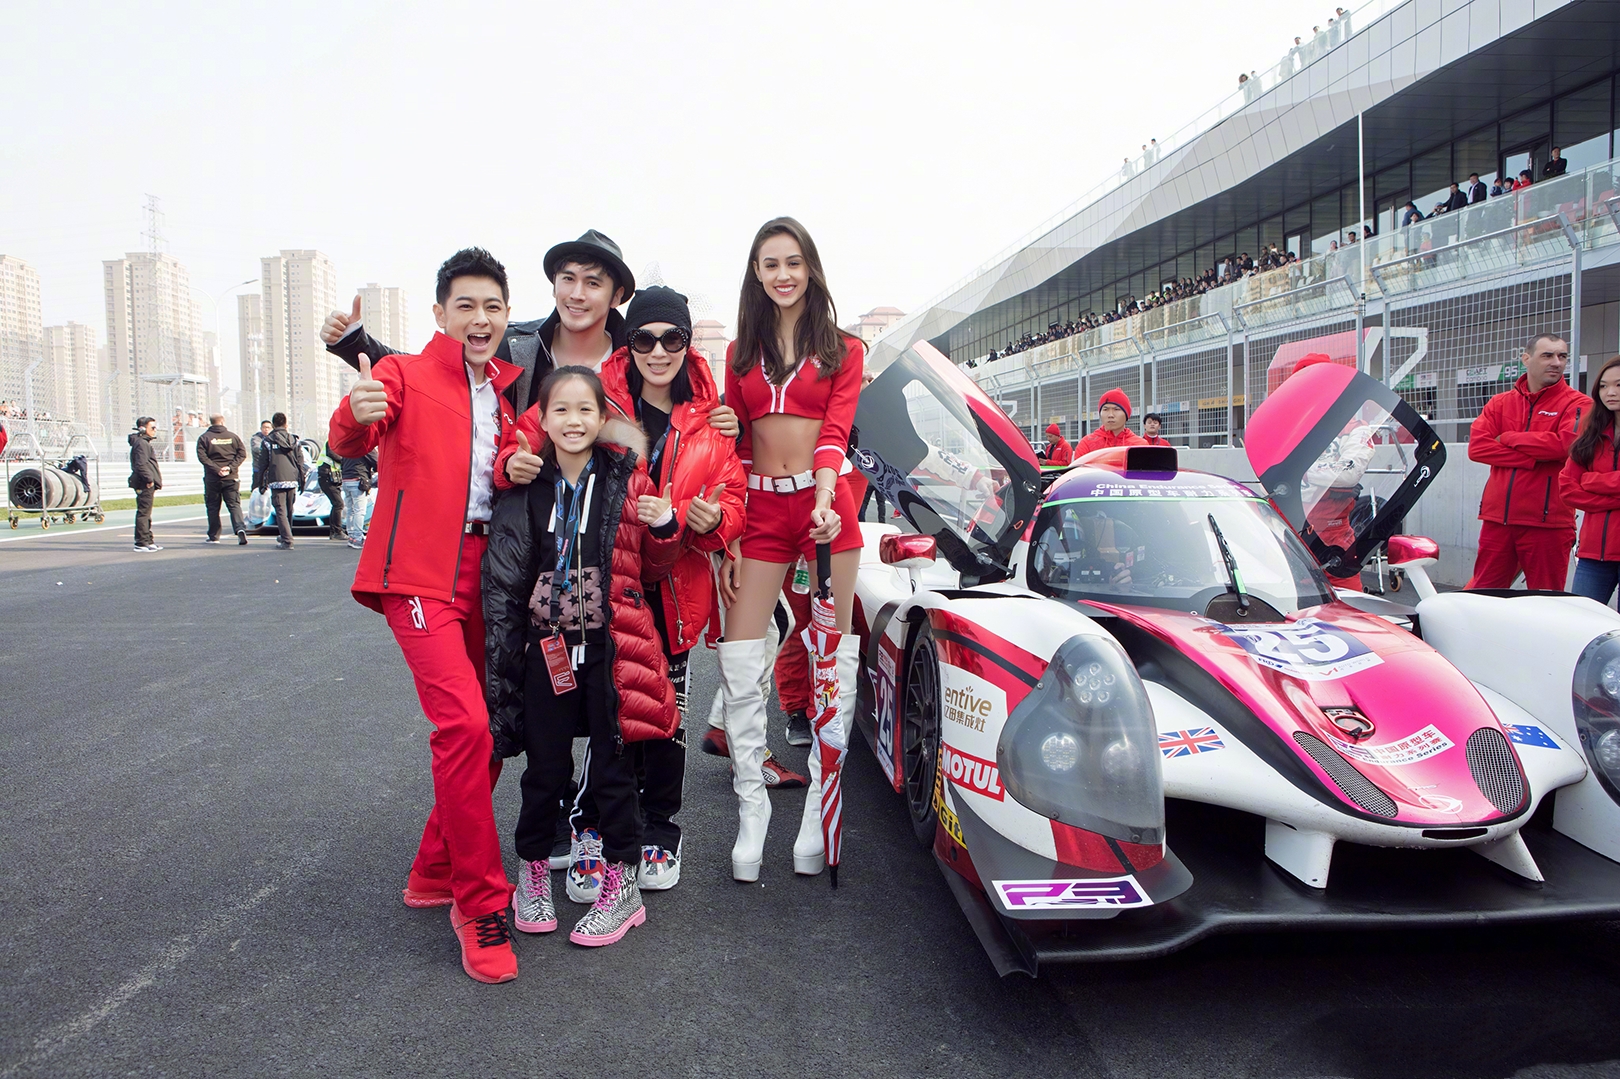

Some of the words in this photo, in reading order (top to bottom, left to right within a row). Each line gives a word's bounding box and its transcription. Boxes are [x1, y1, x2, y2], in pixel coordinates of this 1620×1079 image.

[1504, 365, 1518, 377] 95
[1245, 622, 1350, 664] 25
[880, 676, 893, 757] 25
[945, 686, 992, 717] entive
[1375, 729, 1435, 754] 中国原型车
[1416, 742, 1448, 758] Series
[942, 746, 1001, 795] MOTUL
[941, 806, 966, 843] Git
